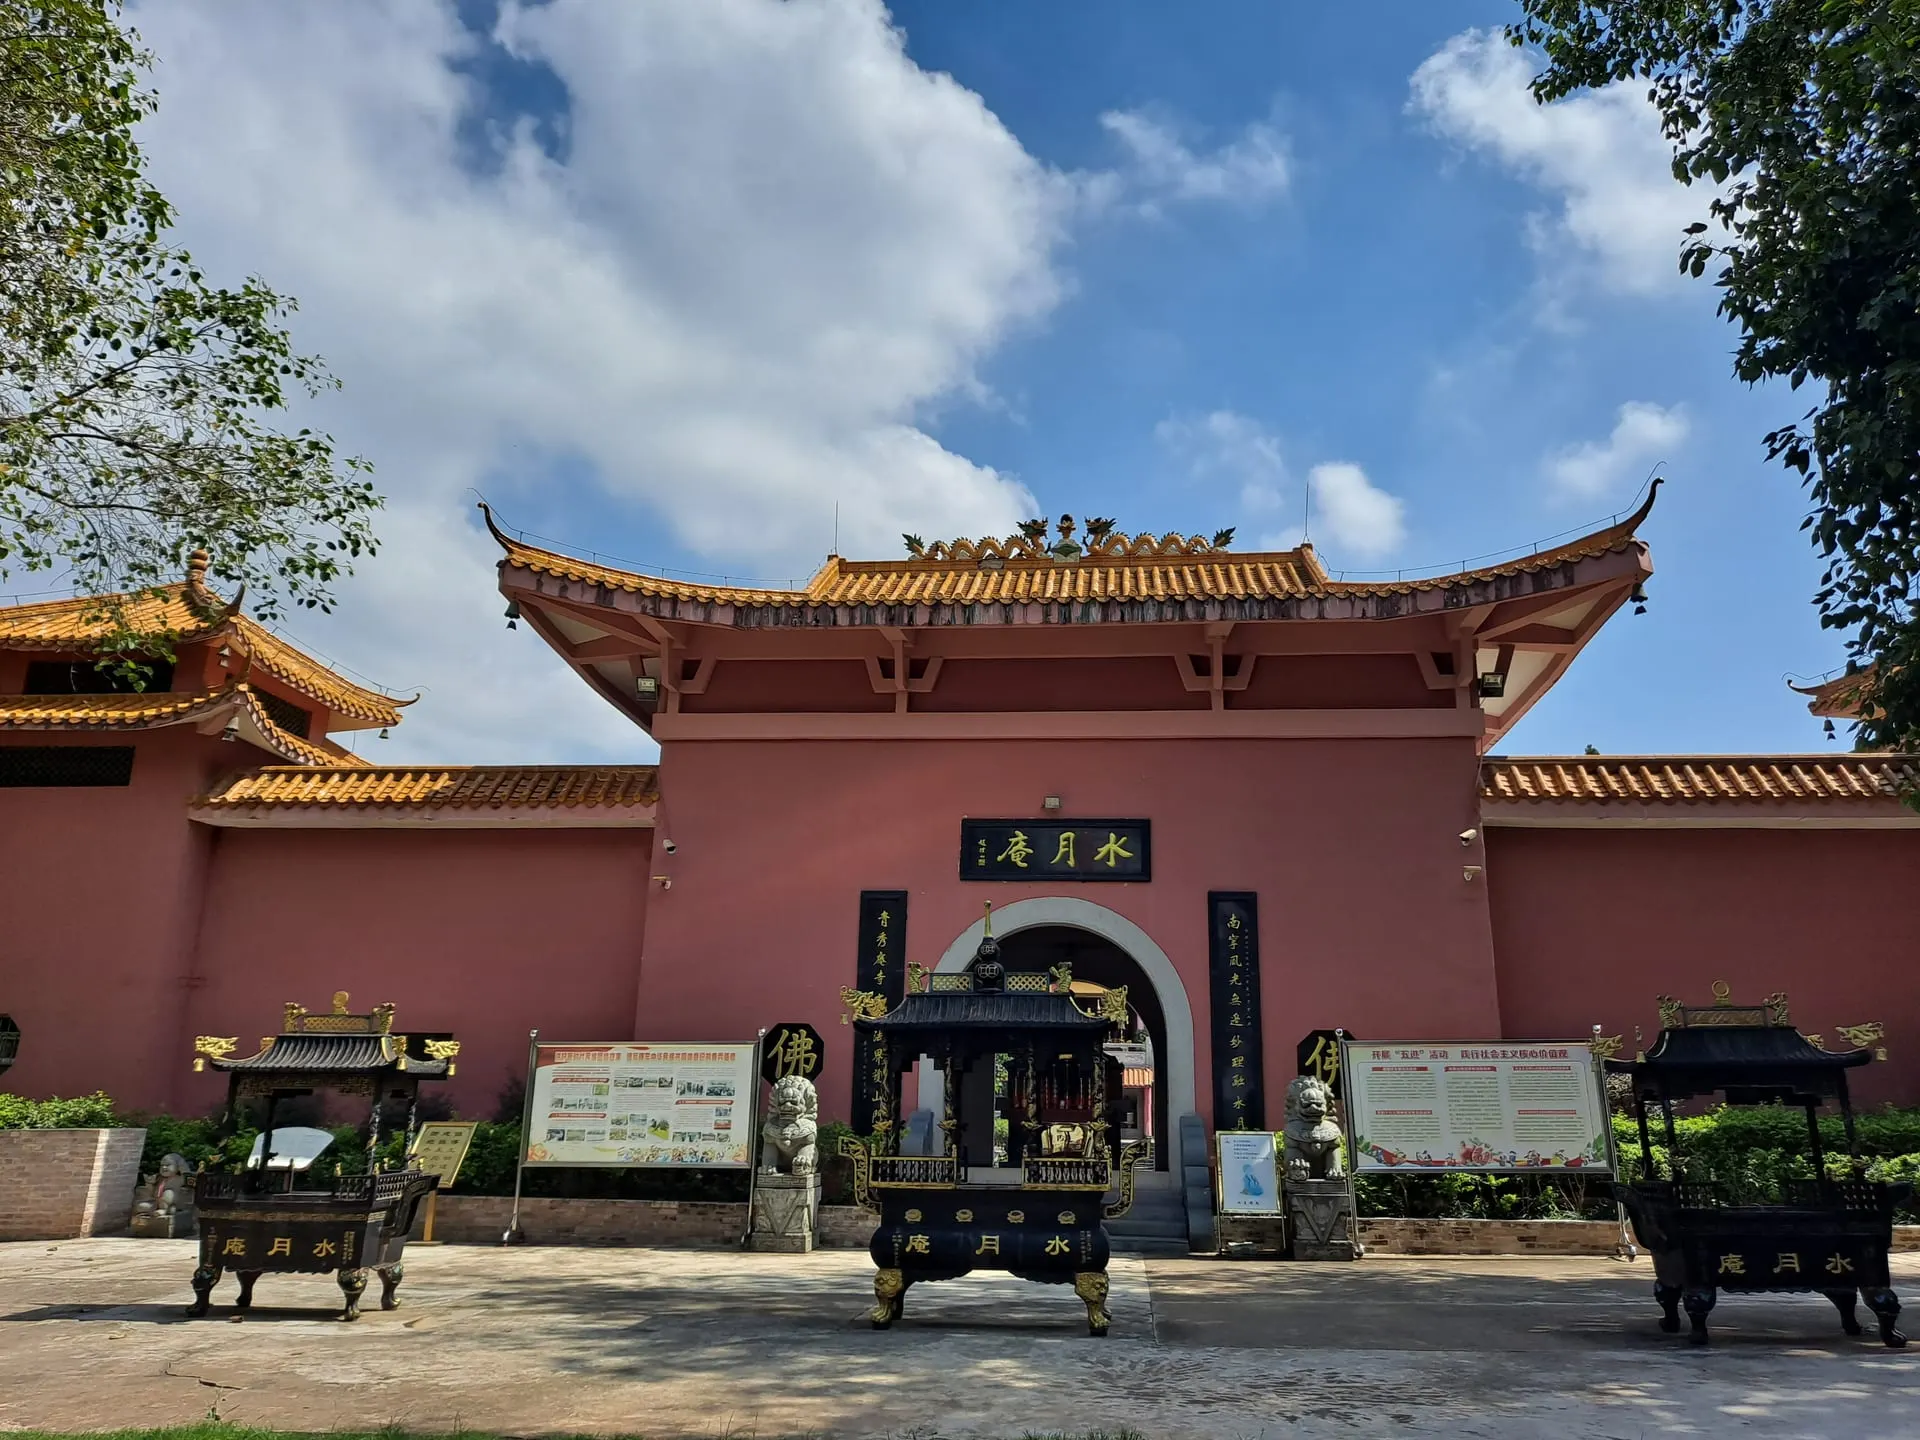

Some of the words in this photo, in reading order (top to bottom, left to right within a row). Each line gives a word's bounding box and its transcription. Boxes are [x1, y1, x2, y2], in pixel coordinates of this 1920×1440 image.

[997, 830, 1134, 868] 水月庵
[767, 1029, 817, 1079] 佛
[222, 1237, 336, 1257] 水月庵
[905, 1234, 1071, 1256] 水月庵
[1718, 1253, 1855, 1274] 水月庵
